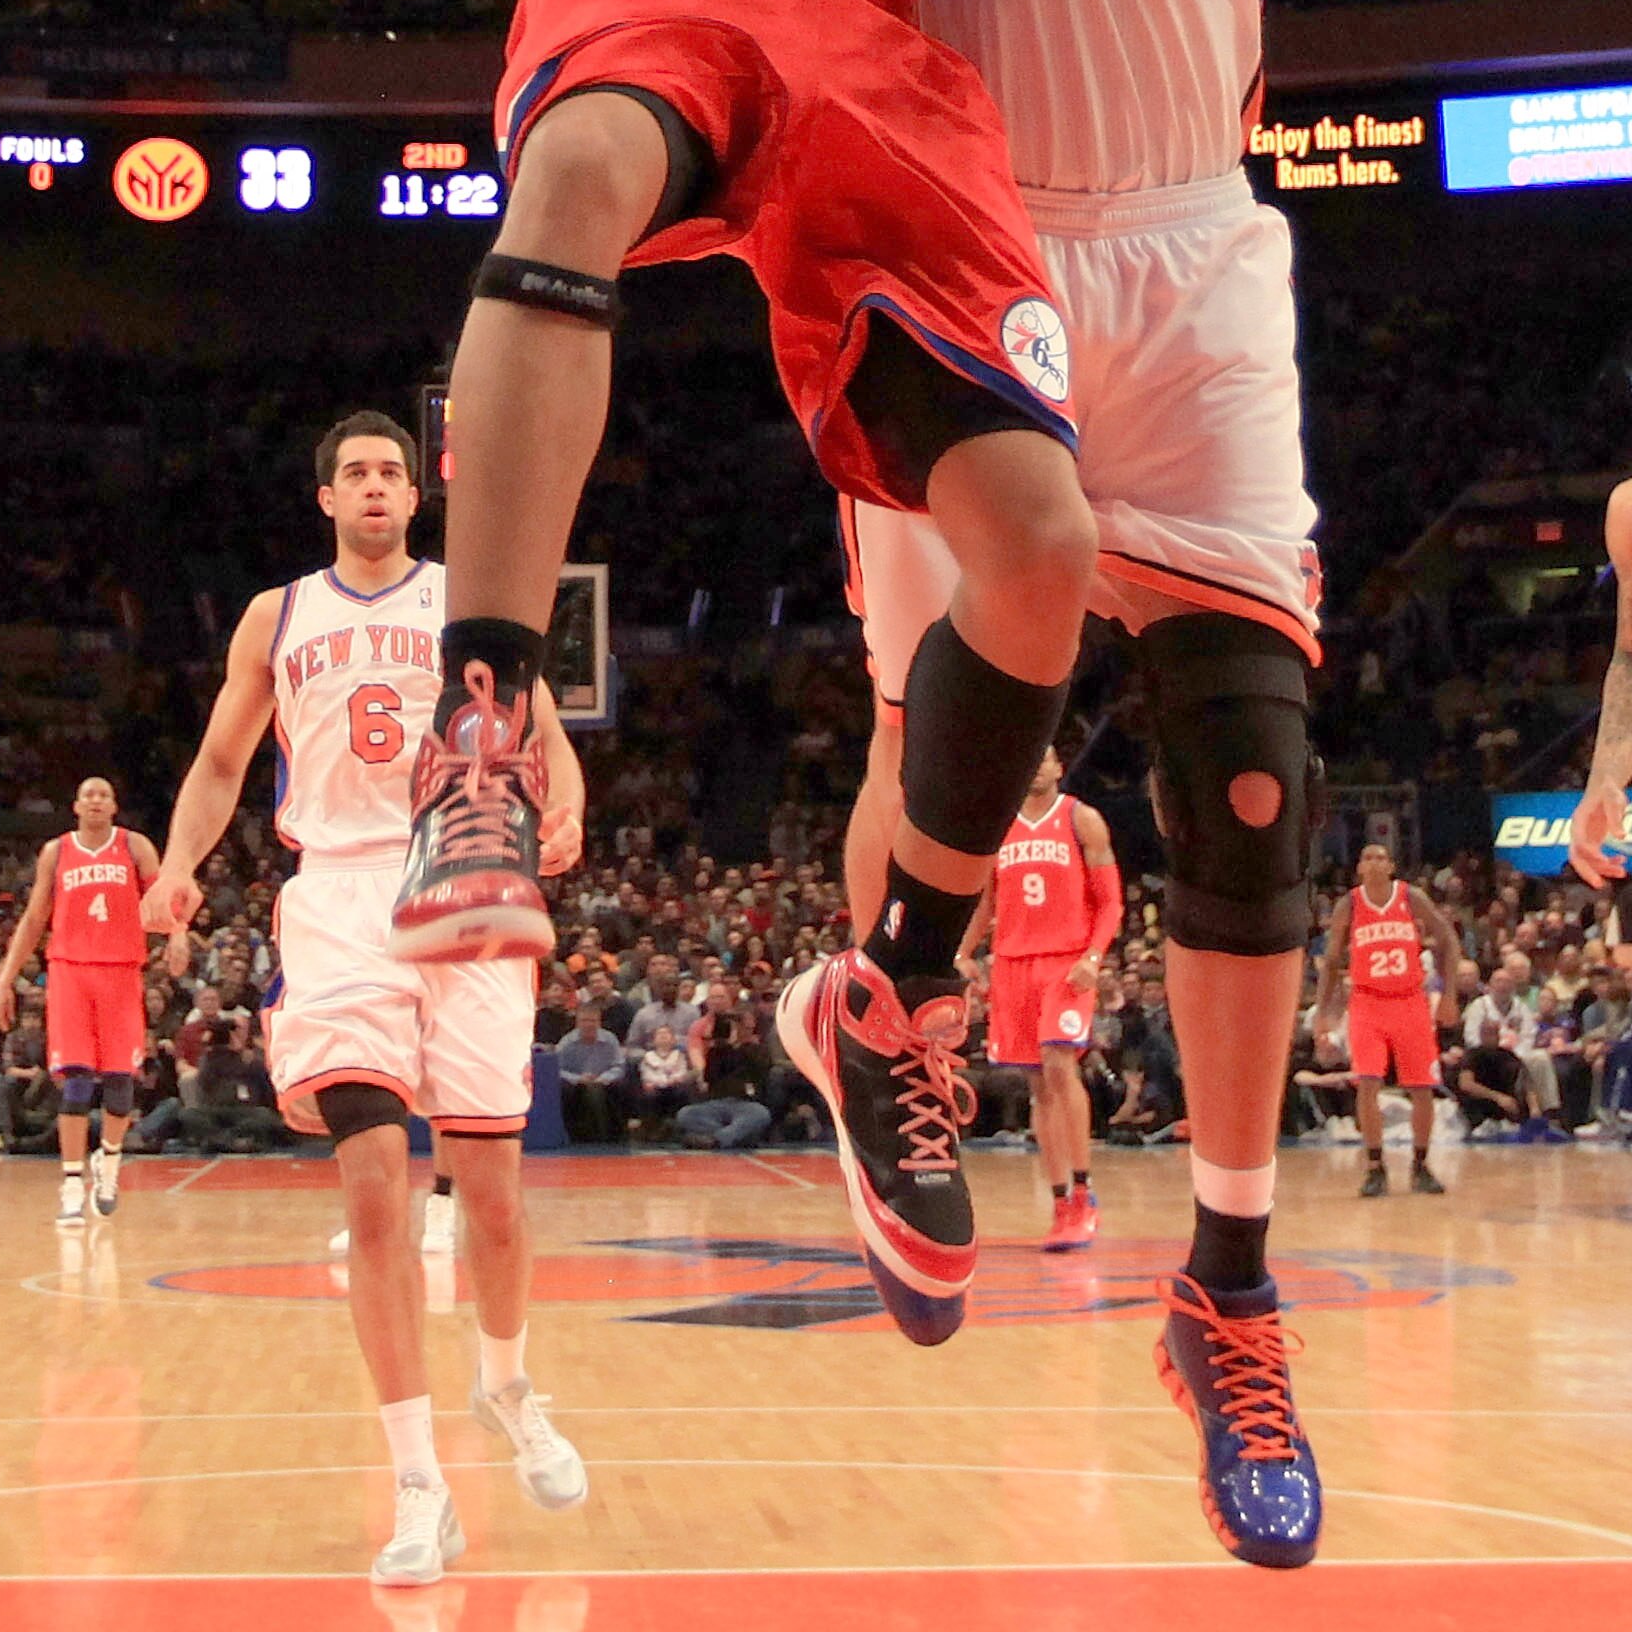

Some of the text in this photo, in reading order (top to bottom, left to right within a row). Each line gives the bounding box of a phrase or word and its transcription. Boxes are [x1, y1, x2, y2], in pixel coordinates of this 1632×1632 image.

[1511, 96, 1576, 124] GAME
[0, 136, 84, 163] FOULS
[1248, 115, 1423, 157] Enjoy the finest
[403, 143, 467, 169] 2ND
[29, 163, 53, 190] 0
[241, 149, 314, 210] 33
[1275, 154, 1398, 190] Rums here.
[380, 175, 499, 216] 11:22
[285, 627, 355, 700] NEW
[347, 684, 404, 764] 6
[998, 839, 1071, 870] SIXERS
[62, 864, 128, 892] SIXERS
[1022, 873, 1047, 906] 9
[88, 893, 109, 922] 4
[1369, 948, 1408, 978] 23
